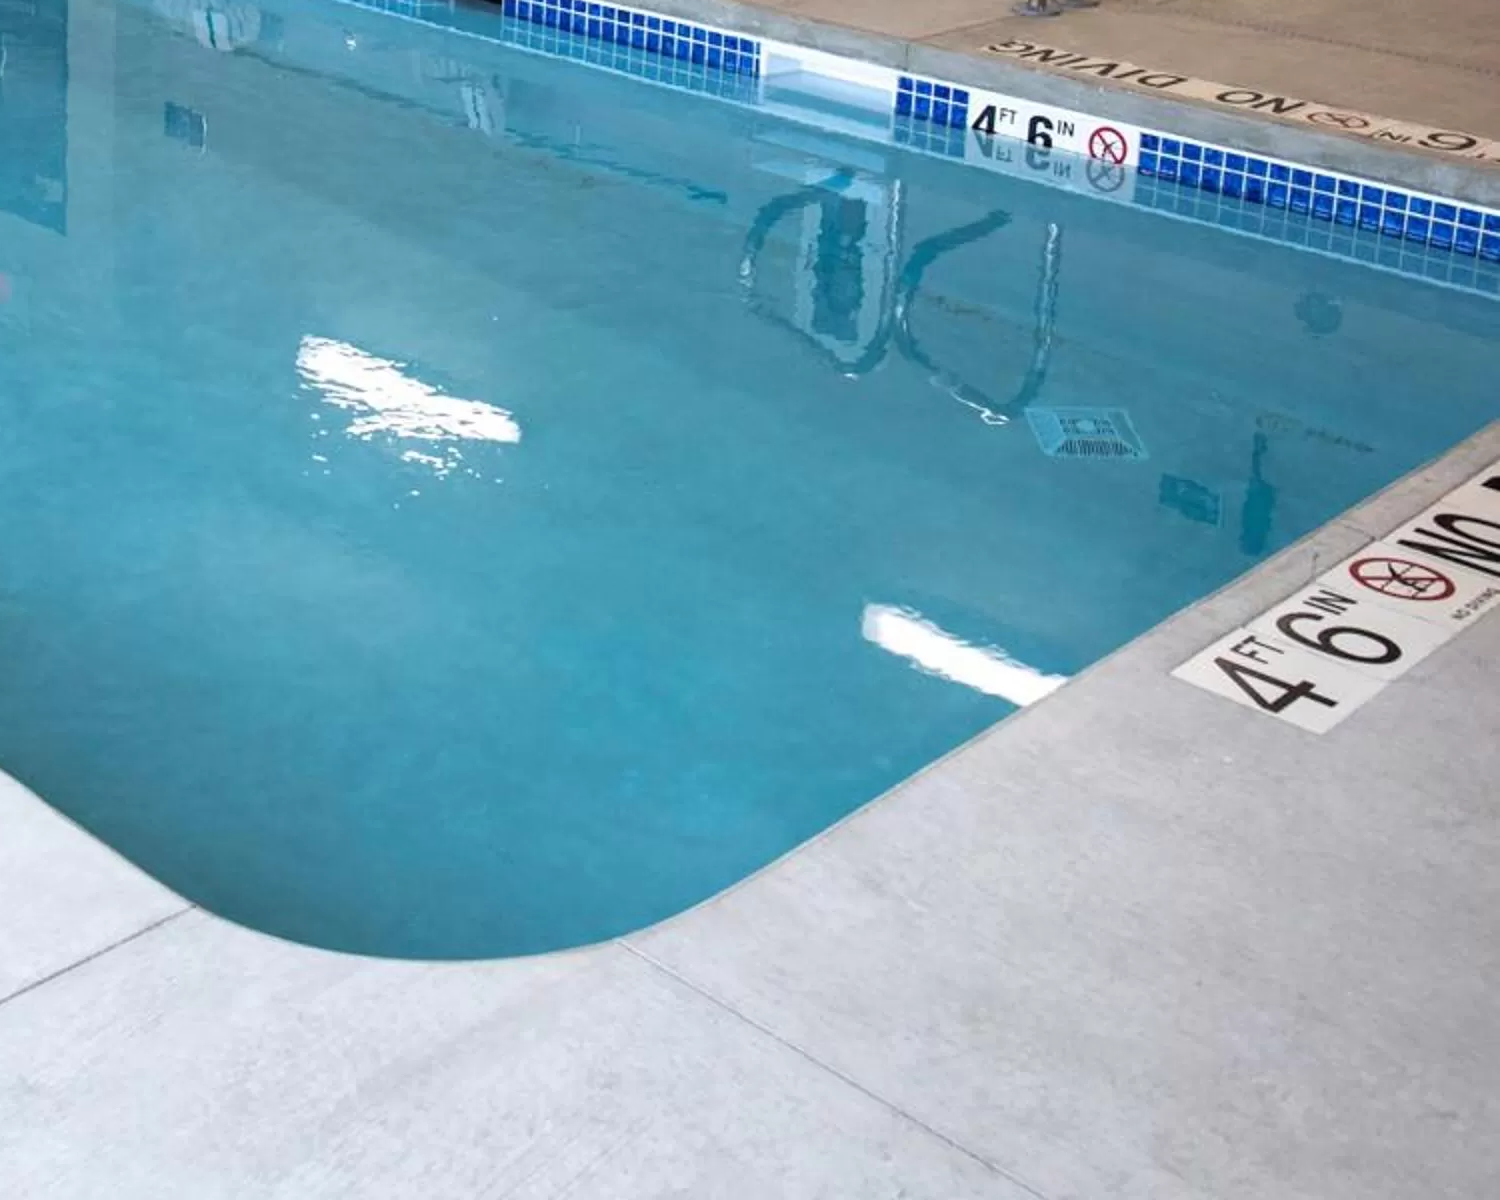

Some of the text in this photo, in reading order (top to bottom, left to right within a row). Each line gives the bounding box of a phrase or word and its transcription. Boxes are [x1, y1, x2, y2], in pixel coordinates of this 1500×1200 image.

[988, 40, 1188, 88] DIVING
[1215, 89, 1305, 114] NO
[972, 104, 1075, 149] 4 FT 6 IN
[1418, 132, 1477, 151] 6
[1214, 513, 1500, 714] 4 FT 6 IN NO
